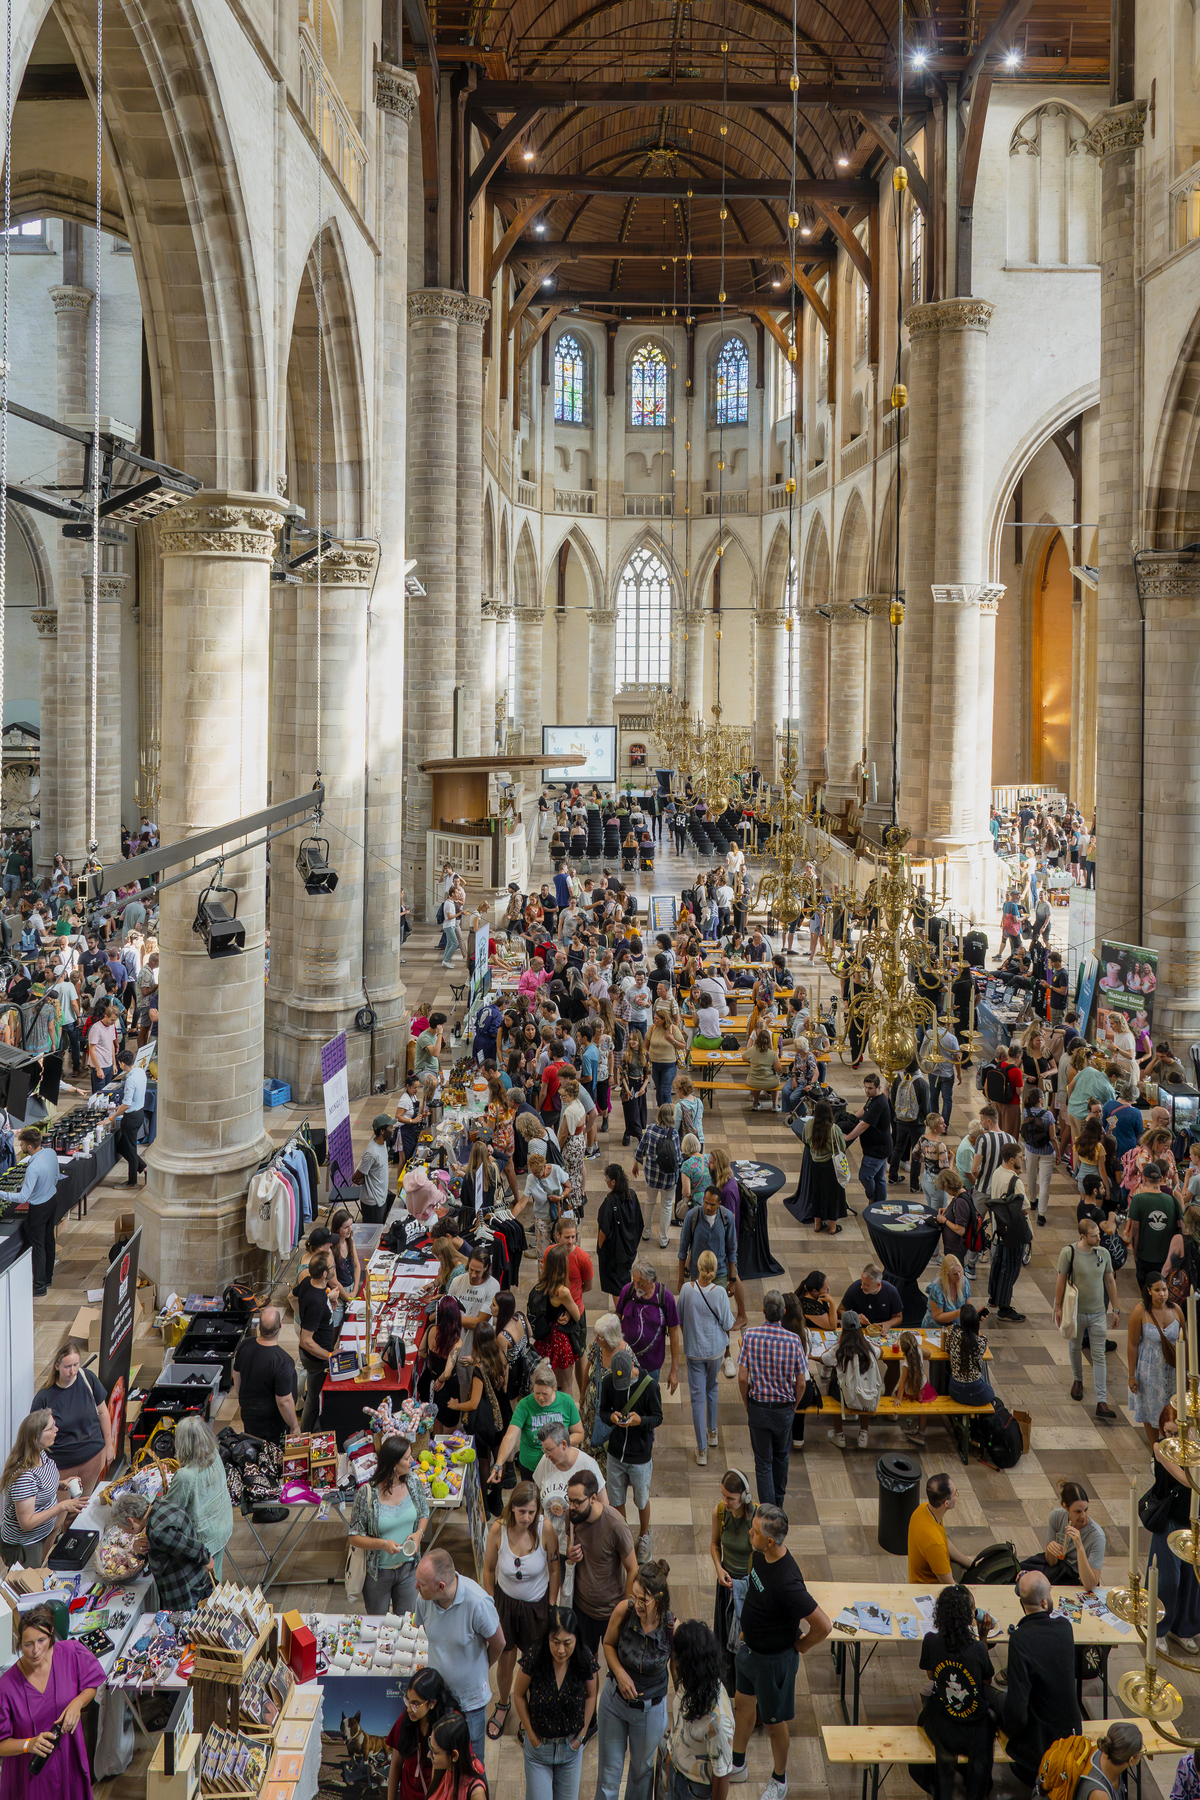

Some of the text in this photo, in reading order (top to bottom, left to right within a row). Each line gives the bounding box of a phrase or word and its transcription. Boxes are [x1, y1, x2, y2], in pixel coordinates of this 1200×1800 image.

[570, 743, 590, 751] NL
[1108, 991, 1144, 1005] Natural Blend
[459, 1295, 483, 1303] PALESTINE
[945, 1660, 963, 1670] TASTE
